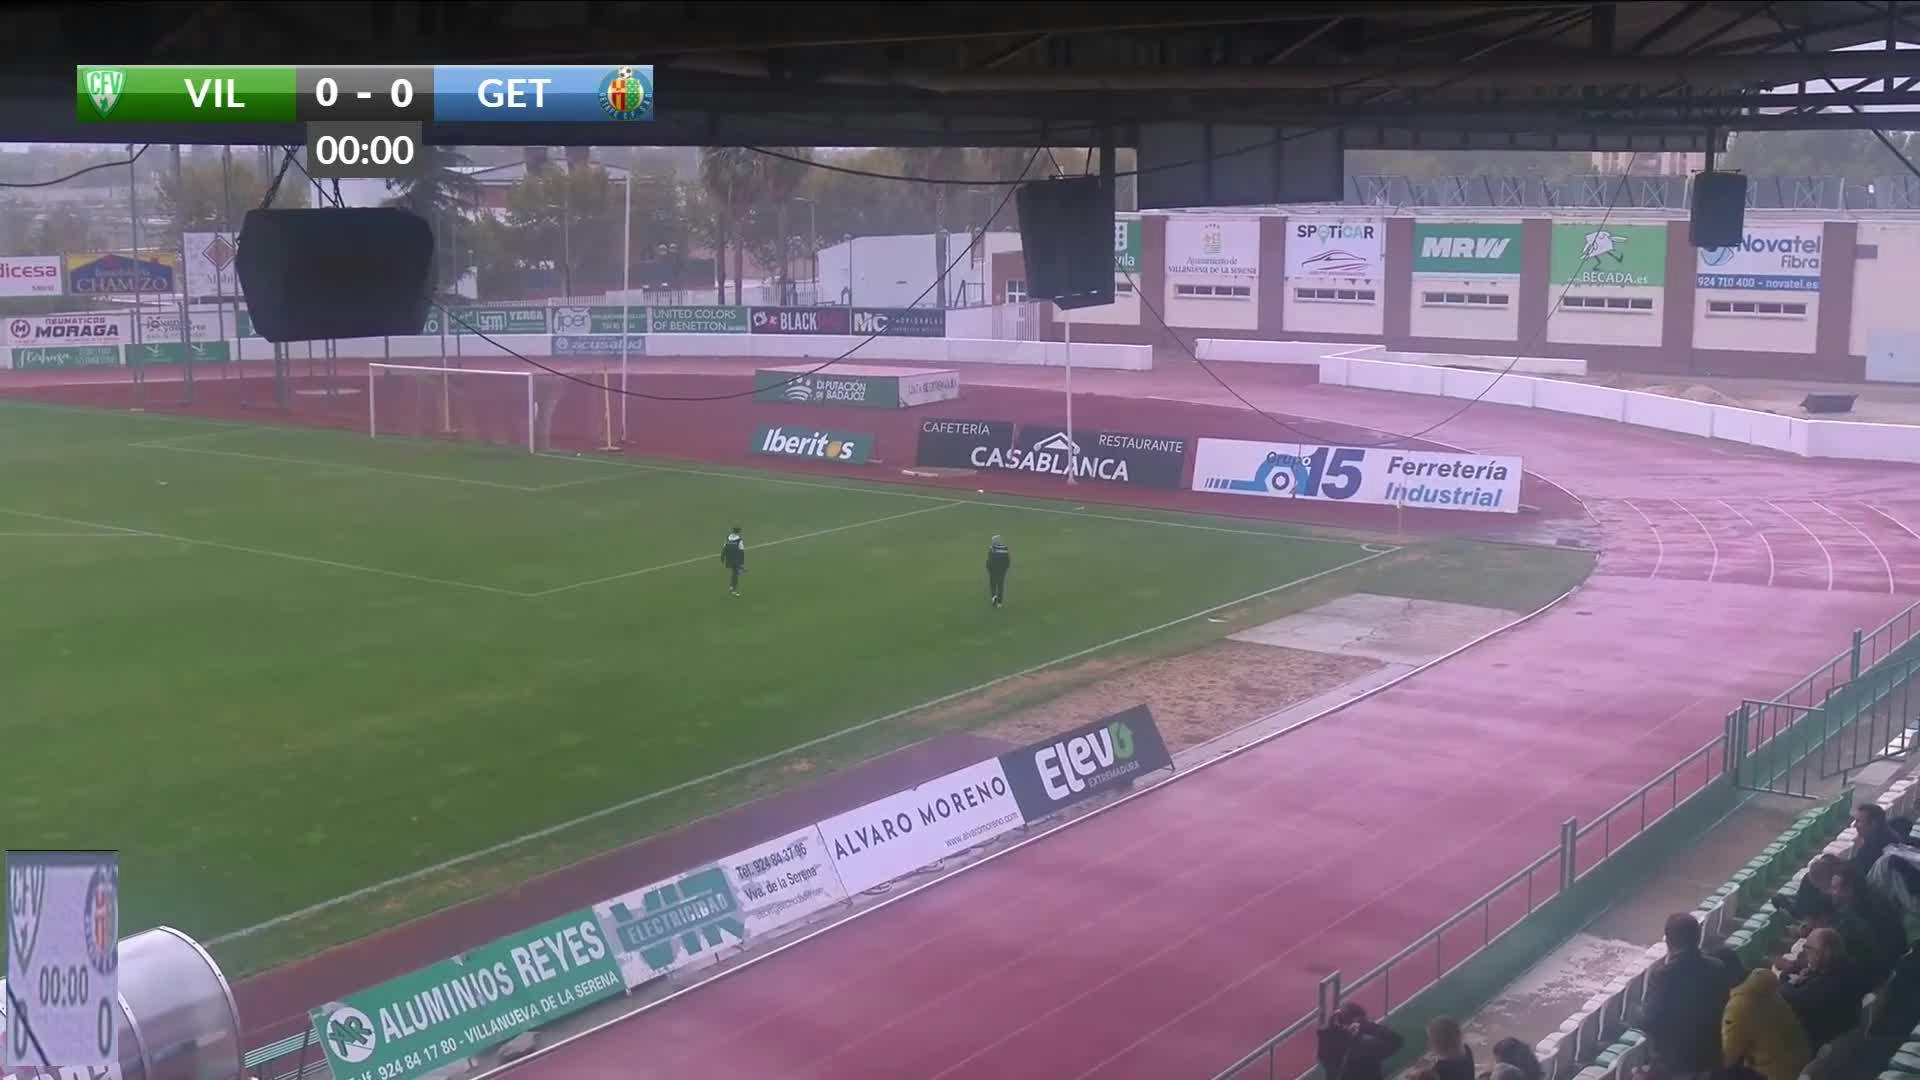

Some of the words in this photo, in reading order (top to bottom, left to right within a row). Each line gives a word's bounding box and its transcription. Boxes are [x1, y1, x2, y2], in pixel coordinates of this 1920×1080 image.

[1421, 236, 1511, 259] MRW
[1736, 233, 1822, 254] Novatel
[1698, 276, 1715, 287] 924
[1716, 277, 1734, 287] 710
[1735, 278, 1755, 288] 400
[1765, 279, 1819, 289] novatel.es
[653, 308, 692, 319] UNITED
[694, 309, 737, 319] COLORS
[653, 320, 668, 331] OF
[670, 320, 727, 331] BENETTON
[780, 311, 817, 331] BLACK
[35, 324, 119, 338] MORAGA
[816, 379, 866, 392] DIPUTACIÓN
[827, 389, 866, 401] BADAJOZ
[922, 421, 991, 437] CAFETERÍA
[761, 427, 855, 460] Iberitos
[1098, 434, 1184, 453] RESTAURANTE
[970, 446, 1129, 482] CASABLANCA
[1305, 447, 1366, 500] 15
[1386, 455, 1509, 481] Ferretería
[1384, 482, 1503, 508] Industrial
[1087, 760, 1141, 788] EXTREMADURA
[833, 812, 914, 861] ALVARO
[919, 776, 1006, 827] MORENO
[744, 887, 766, 902] Vva.
[766, 880, 778, 894] de
[777, 877, 788, 890] la
[786, 866, 818, 886] Serena
[627, 892, 730, 945] ELECTRICIDAD
[378, 961, 514, 1044] ALUMINIOS
[510, 920, 606, 988] REYES
[378, 1059, 403, 1080] 924
[404, 1053, 422, 1070] 84
[423, 1044, 439, 1061] 17
[440, 1037, 457, 1055] 80
[464, 1003, 541, 1044] VILLANUEVA
[540, 994, 558, 1012] DE
[557, 988, 575, 1006] LA
[574, 969, 620, 999] SERENA
